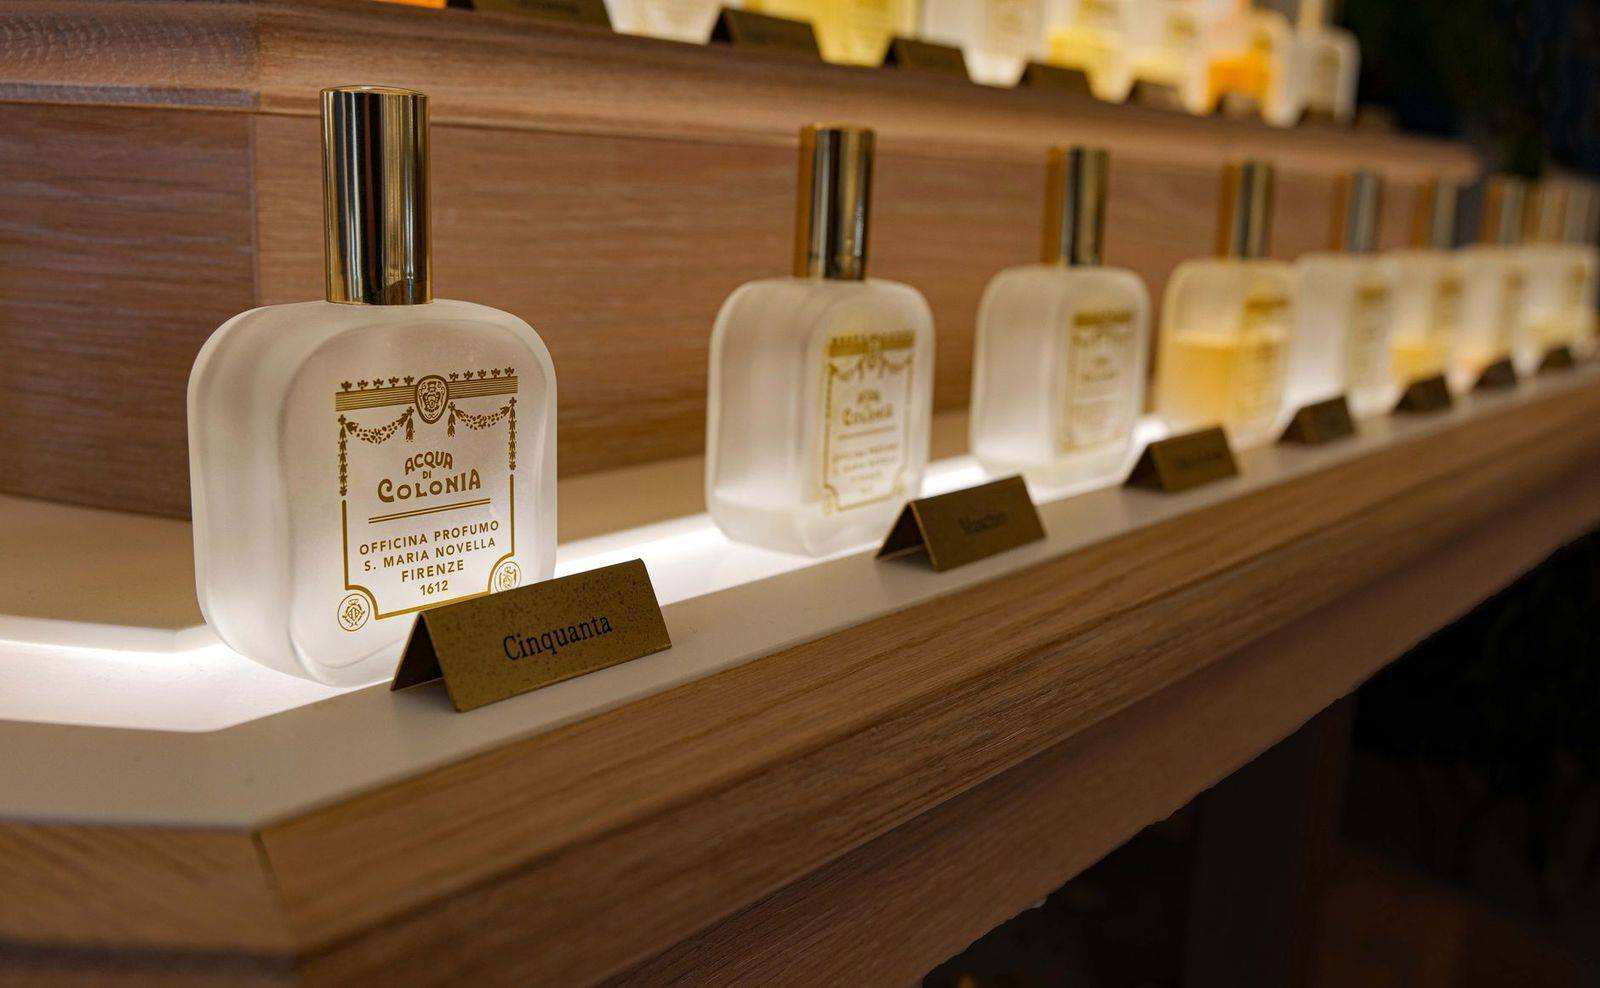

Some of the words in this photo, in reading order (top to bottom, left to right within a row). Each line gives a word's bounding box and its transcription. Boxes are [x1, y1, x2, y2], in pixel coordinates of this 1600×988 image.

[404, 451, 453, 475] ACQUA
[422, 470, 432, 480] DI
[377, 468, 481, 503] COLONIA
[359, 533, 428, 555] OFFICINA
[434, 520, 500, 542] PROFUMO
[364, 560, 377, 572] S.
[384, 551, 430, 568] MARIA
[435, 537, 496, 559] NOVELLA
[401, 559, 464, 582] FIRENZE
[420, 580, 449, 596] 1612
[503, 616, 613, 660] Cinquanta
